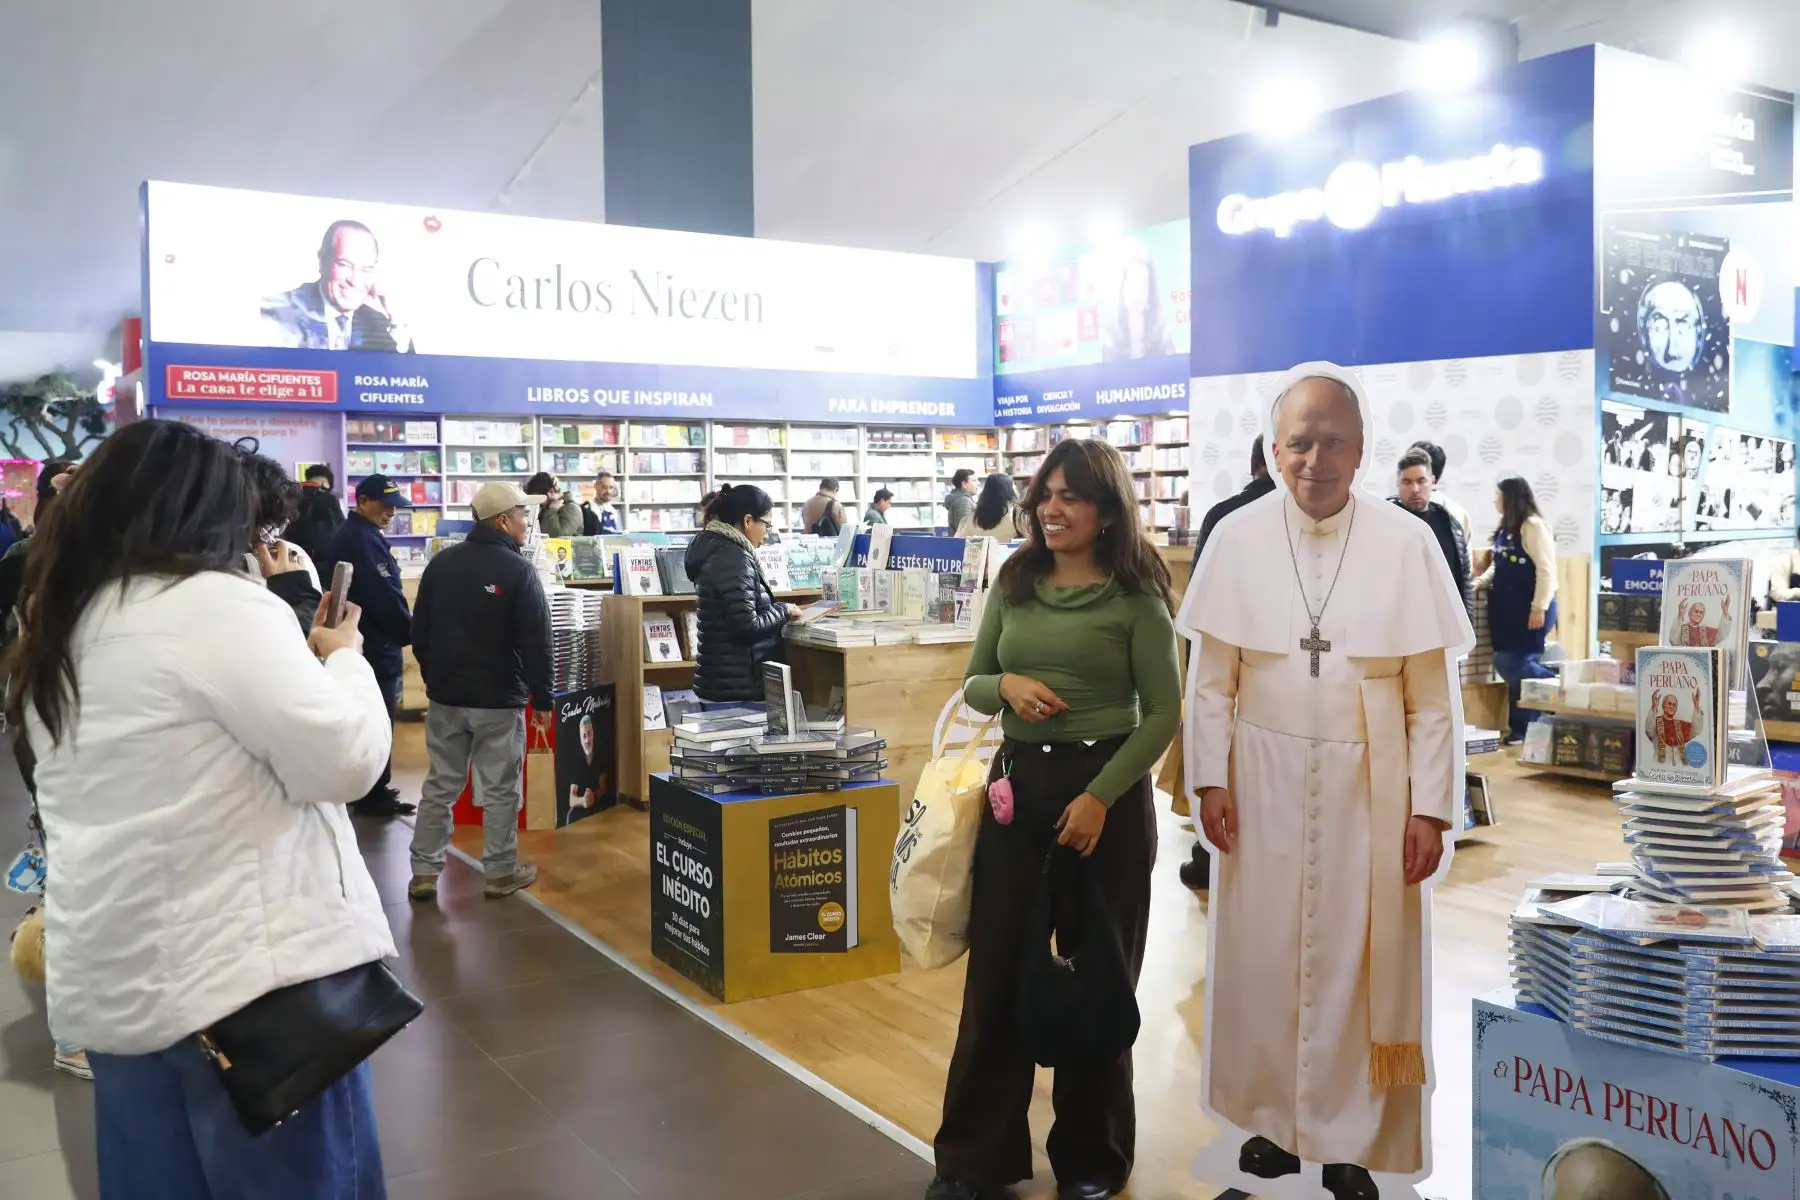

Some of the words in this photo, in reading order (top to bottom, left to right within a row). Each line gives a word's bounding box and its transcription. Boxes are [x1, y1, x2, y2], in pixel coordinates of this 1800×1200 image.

[467, 257, 612, 314] Carlos
[630, 268, 764, 323] Niezen
[1736, 268, 1747, 306] N
[184, 370, 216, 382] ROSA
[218, 370, 257, 384] MARÍA
[259, 373, 320, 386] CIFUENTES
[355, 376, 388, 387] ROSA
[390, 376, 428, 388] MARÍA
[176, 382, 196, 394] La
[200, 385, 235, 395] casa
[240, 384, 254, 396] te
[260, 384, 294, 399] elige
[298, 388, 307, 398] a
[310, 386, 323, 398] ti
[360, 392, 424, 404] CIFUENTES
[527, 386, 590, 404] LIBROS
[594, 388, 630, 407] QUE
[634, 390, 713, 407] INSPIRAN
[1043, 391, 1067, 401] CIENCIA
[1096, 383, 1186, 404] HUMANIDADES
[828, 398, 868, 414] PARA
[872, 400, 955, 417] EMPRENDER
[997, 396, 1014, 406] VIAJA
[1016, 395, 1028, 404] POR
[1037, 401, 1081, 415] DIVULGACIÓN
[995, 409, 1002, 418] LA
[1004, 406, 1032, 417] HISTORIA
[858, 554, 868, 566] PA
[897, 554, 920, 568] ESTÉS
[923, 558, 934, 570] EN
[936, 558, 948, 572] TU
[951, 560, 962, 573] PR
[1650, 569, 1664, 578] PA
[1692, 570, 1718, 583] PAPA
[1678, 584, 1728, 597] PERUANO
[1662, 661, 1688, 674] PAPA
[1650, 675, 1697, 688] PERUANO
[663, 812, 682, 830] EDICIÓN
[683, 824, 707, 842] ESPECIAL
[782, 830, 802, 838] Cambios
[803, 826, 830, 835] pequeños,
[678, 837, 692, 850] Incluye
[774, 839, 798, 848] resultados
[800, 833, 838, 844] extraordinarios
[656, 841, 670, 867] EL
[672, 850, 713, 890] CURSO
[774, 848, 842, 872] Hábitos
[774, 870, 842, 890] Atómicos
[662, 874, 710, 919] INÉDITO
[672, 912, 678, 922] 30
[678, 915, 688, 929] días
[689, 923, 700, 937] para
[664, 922, 682, 939] mejorar
[683, 932, 691, 944] tus
[692, 936, 710, 956] hábitos
[785, 933, 806, 941] James
[807, 932, 826, 940] Clear
[1513, 1056, 1594, 1116] PAPA
[1603, 1082, 1776, 1171] PERUANO
